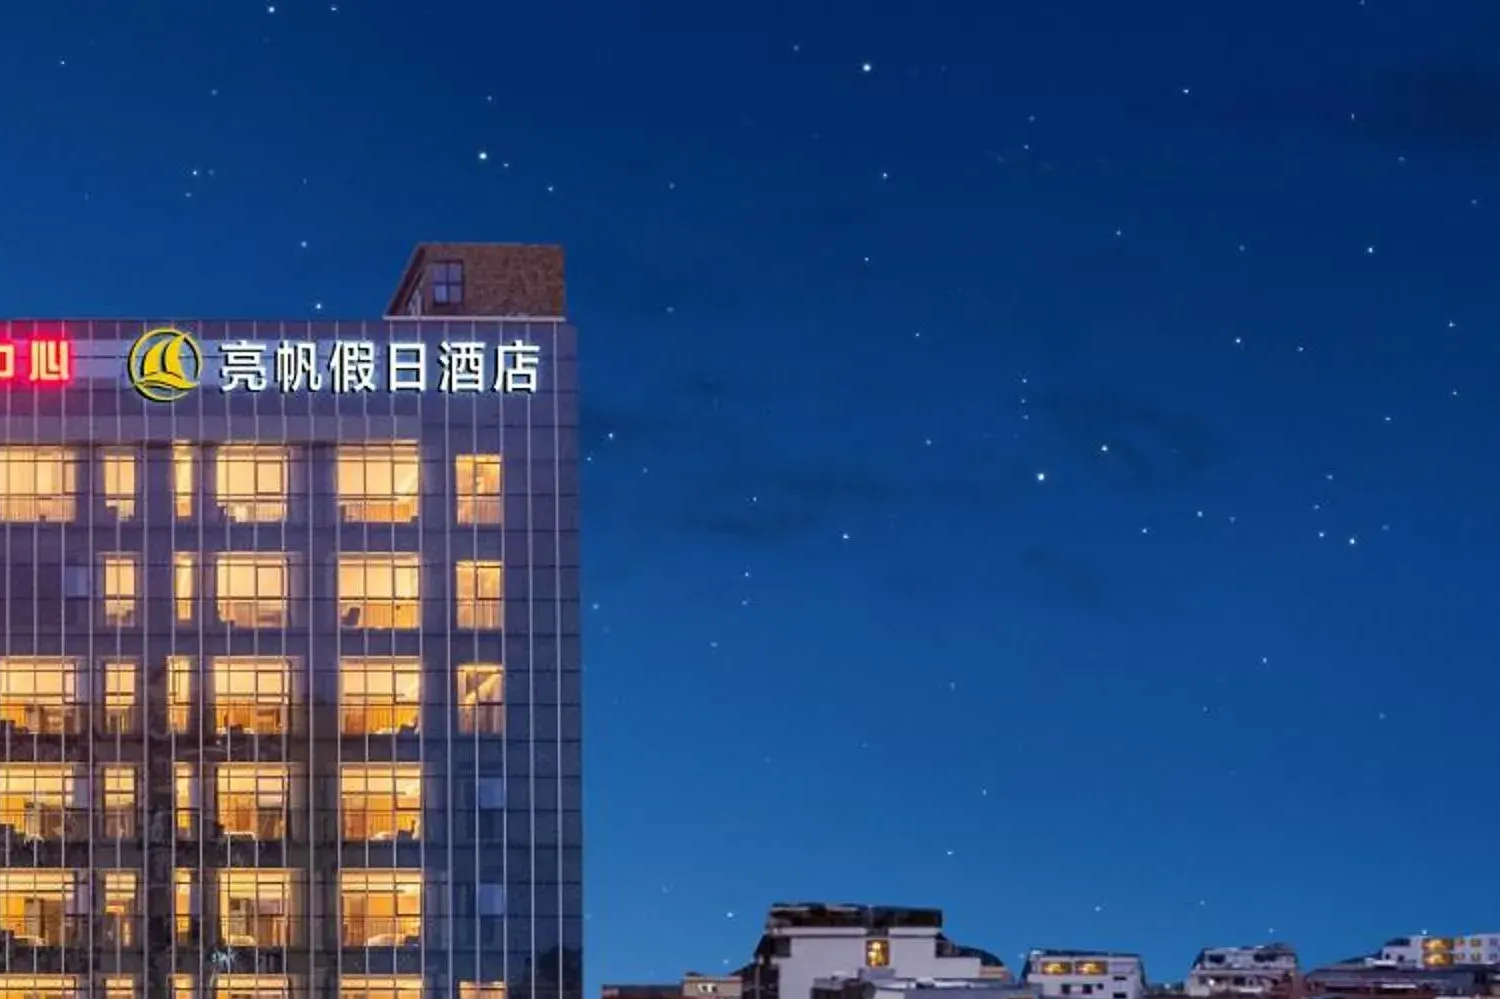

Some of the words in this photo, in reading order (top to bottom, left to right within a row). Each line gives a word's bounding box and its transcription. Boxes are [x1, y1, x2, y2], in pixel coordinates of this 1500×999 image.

[219, 339, 541, 392] 亮帆假日酒店
